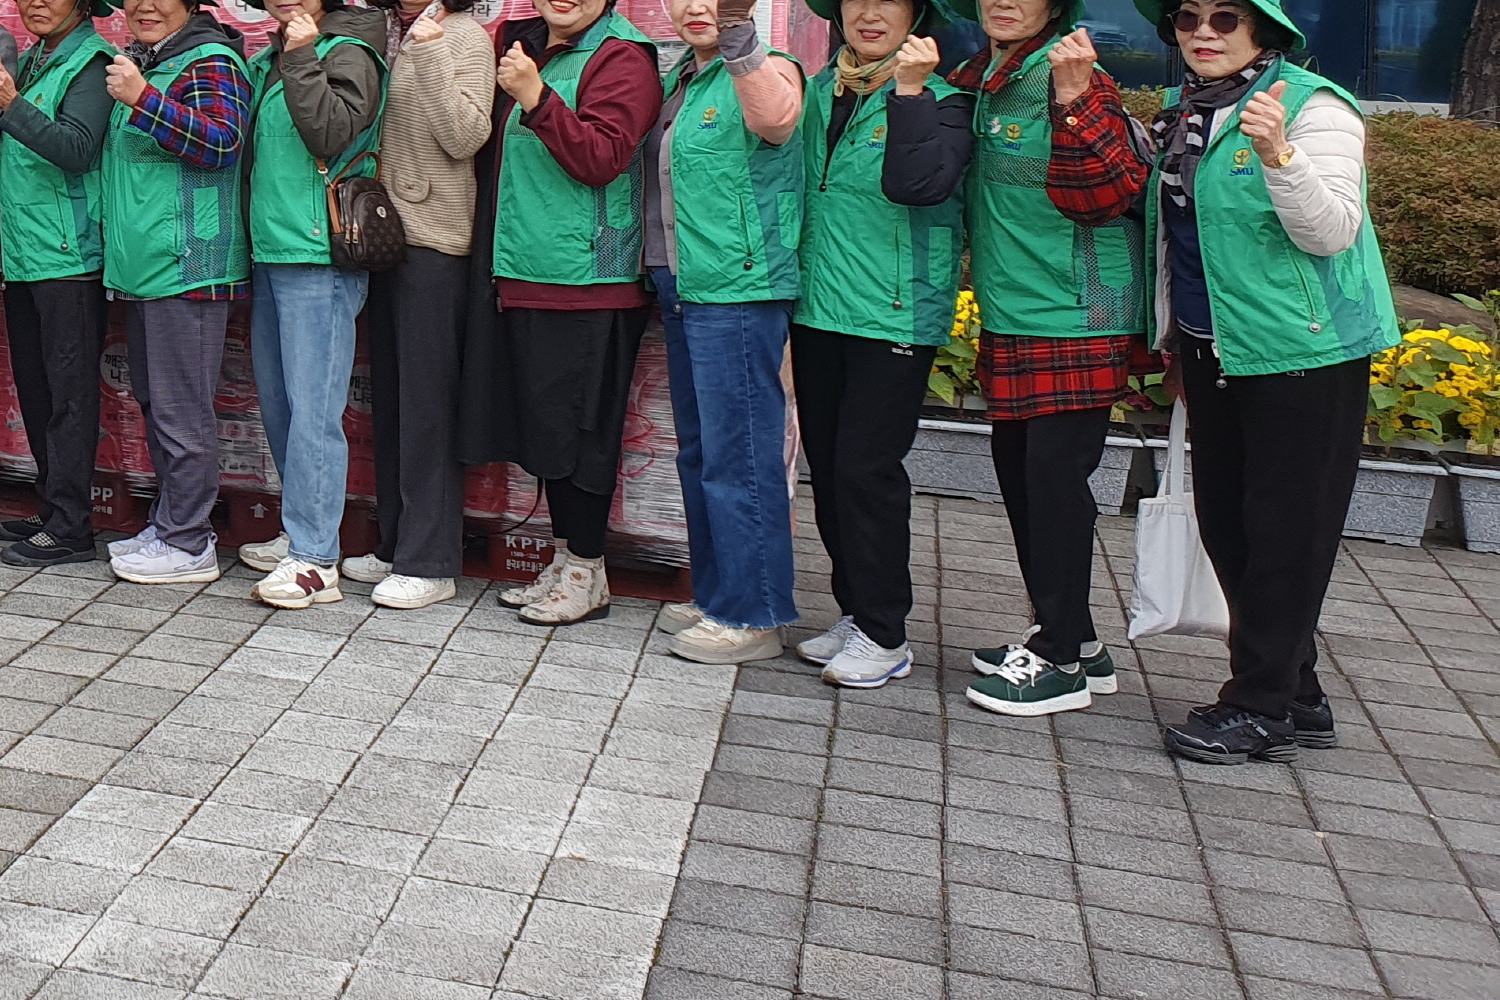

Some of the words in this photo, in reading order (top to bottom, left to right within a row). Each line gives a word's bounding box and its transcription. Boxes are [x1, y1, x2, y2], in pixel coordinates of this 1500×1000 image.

[1229, 167, 1254, 176] SMU
[90, 486, 114, 502] PP
[505, 535, 548, 551] KPP
